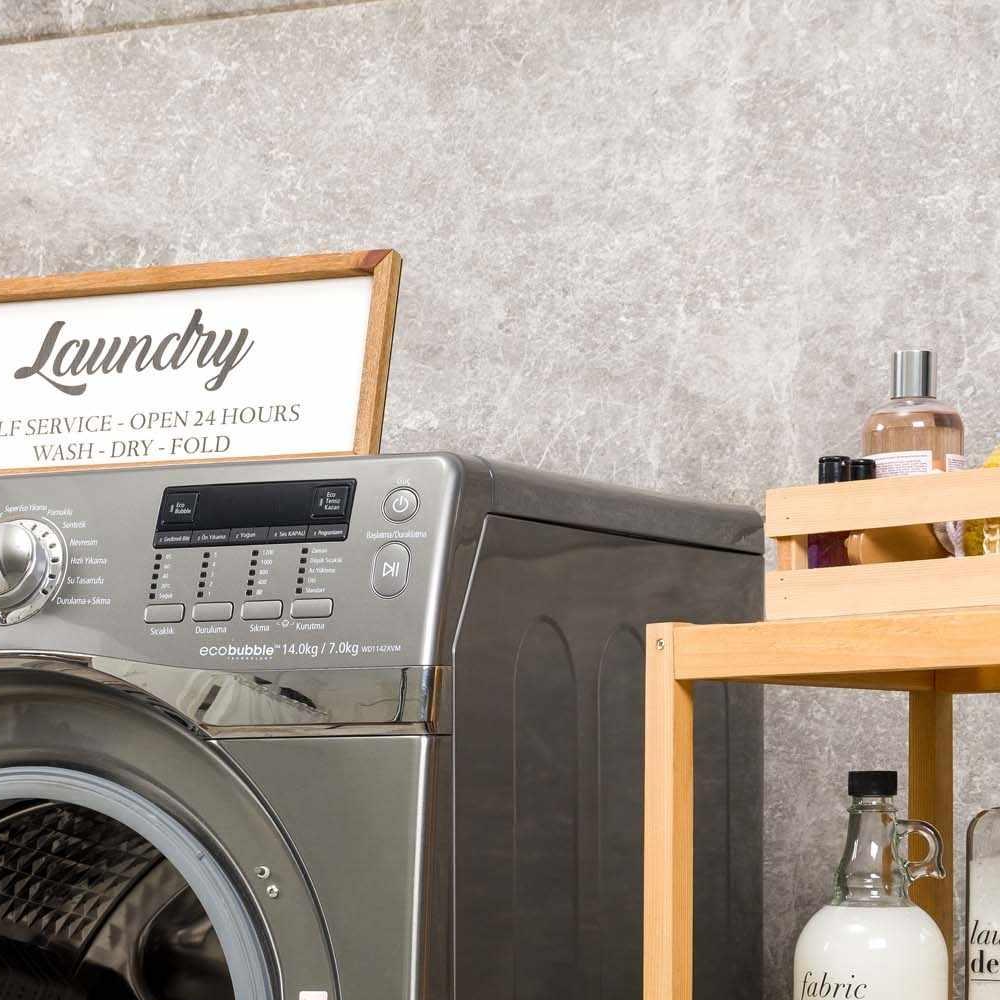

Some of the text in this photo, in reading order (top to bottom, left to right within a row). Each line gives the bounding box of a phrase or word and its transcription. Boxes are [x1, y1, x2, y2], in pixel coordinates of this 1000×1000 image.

[14, 309, 254, 396] Laundry
[25, 414, 113, 436] SERVICE
[130, 410, 189, 431] OPEN
[193, 409, 216, 427] 24
[222, 404, 301, 425] HOURS
[33, 442, 95, 462] WASH
[110, 439, 154, 459] DRY
[171, 435, 231, 455] FOLD
[295, 622, 325, 631] Kurutma
[199, 643, 274, 656] ecobubble
[282, 642, 319, 658] 14.0kg
[329, 641, 359, 656] 7.0kg
